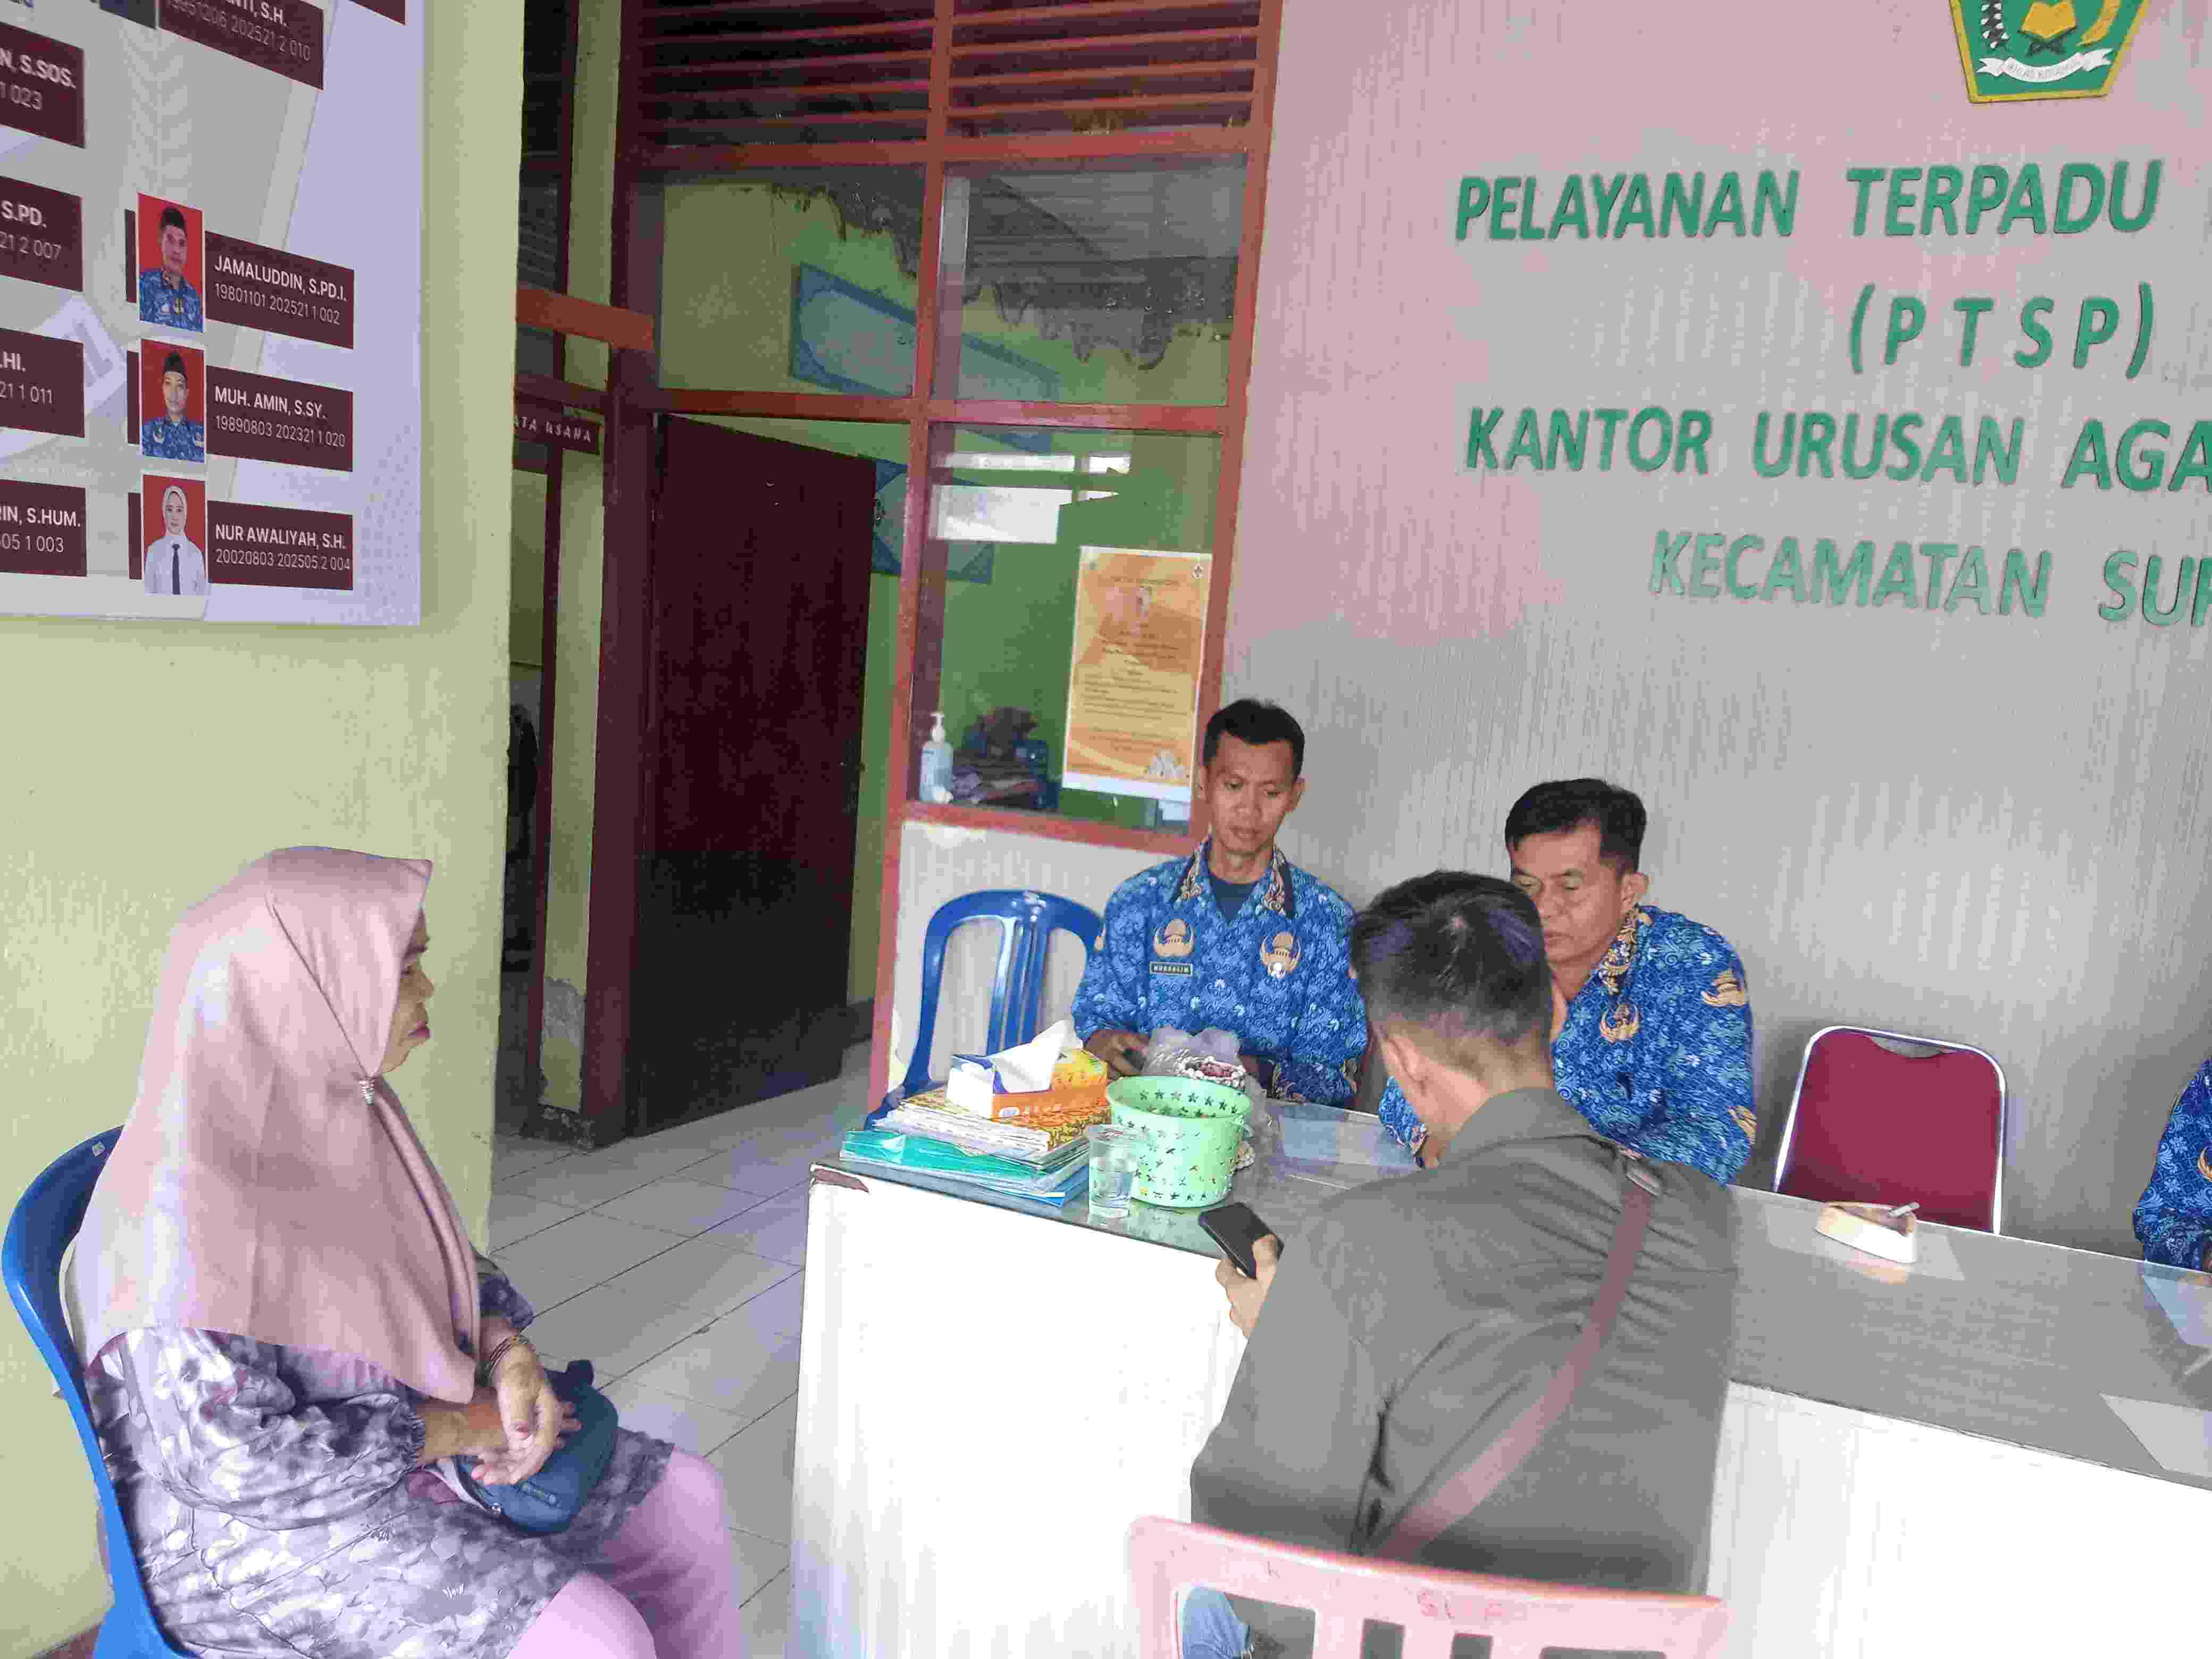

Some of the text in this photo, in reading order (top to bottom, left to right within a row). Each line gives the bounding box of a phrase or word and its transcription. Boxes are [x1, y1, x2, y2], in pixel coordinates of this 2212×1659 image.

[261, 1, 288, 27] S.H.
[290, 40, 311, 61] 010
[20, 54, 77, 89] S.SOS.
[1, 200, 47, 228] S.PD.
[1455, 160, 2162, 240] PELAYANAN TERPADU
[19, 236, 29, 254] 2
[33, 239, 62, 259] 007
[215, 255, 348, 301] JAMALUDDIN, S.PD.I.
[215, 283, 340, 325] 19801101 202521 1 002
[18, 383, 24, 400] 1
[30, 386, 52, 404] 011
[215, 386, 326, 418] MUH. AMIN, S.SY.
[216, 415, 345, 447] 19890803 202321 1 020
[1465, 407, 1713, 476] KANTOR
[1752, 411, 2022, 486] URUSAN
[27, 507, 80, 527] S.HUM.
[25, 535, 30, 551] 1
[37, 535, 64, 552] 003
[215, 523, 347, 550] NUR AWALIYAH, S.H.
[216, 548, 351, 571] 20020803 202505 2 004
[1648, 531, 2052, 618] KECAMATAN
